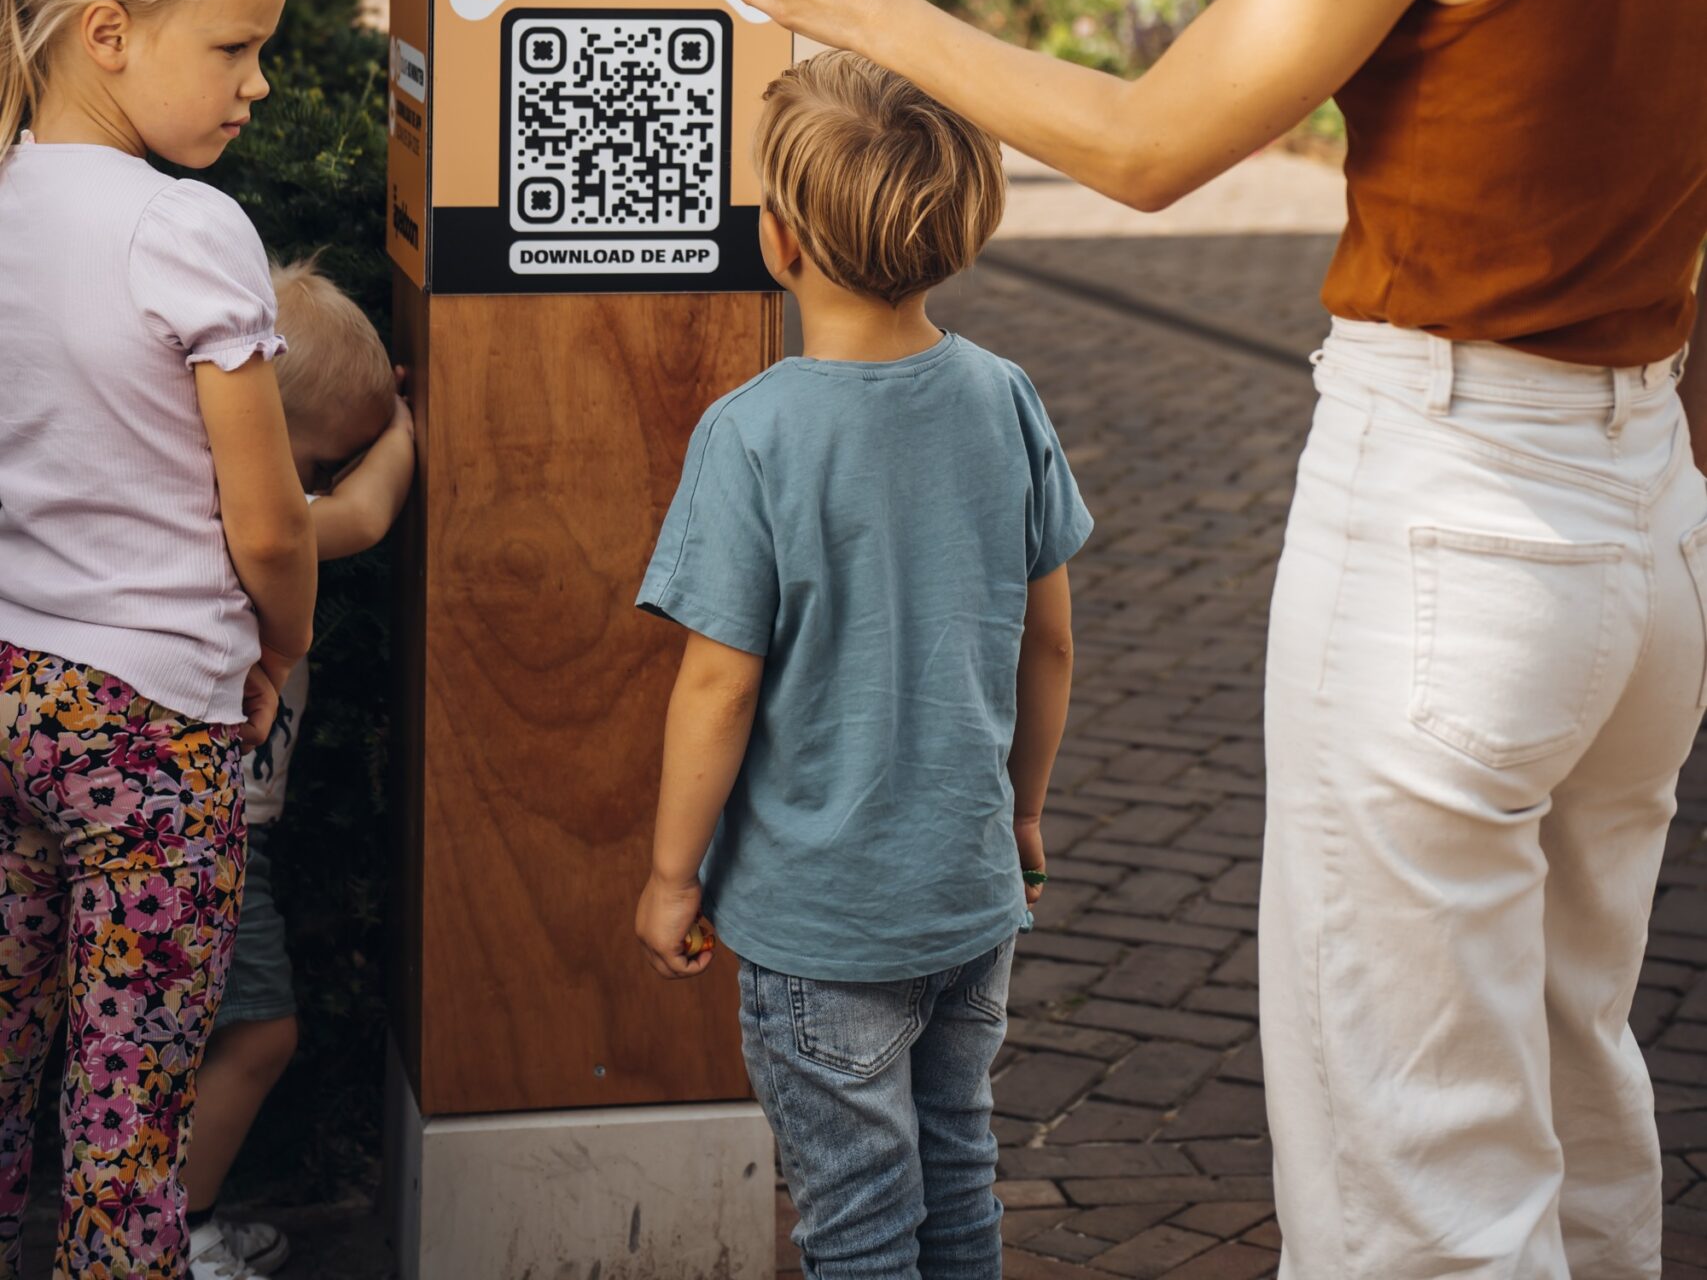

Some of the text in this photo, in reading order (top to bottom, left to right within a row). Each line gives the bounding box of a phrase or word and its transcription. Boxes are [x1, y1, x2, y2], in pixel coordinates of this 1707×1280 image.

[520, 249, 710, 264] DOWNLOAD DE APP
